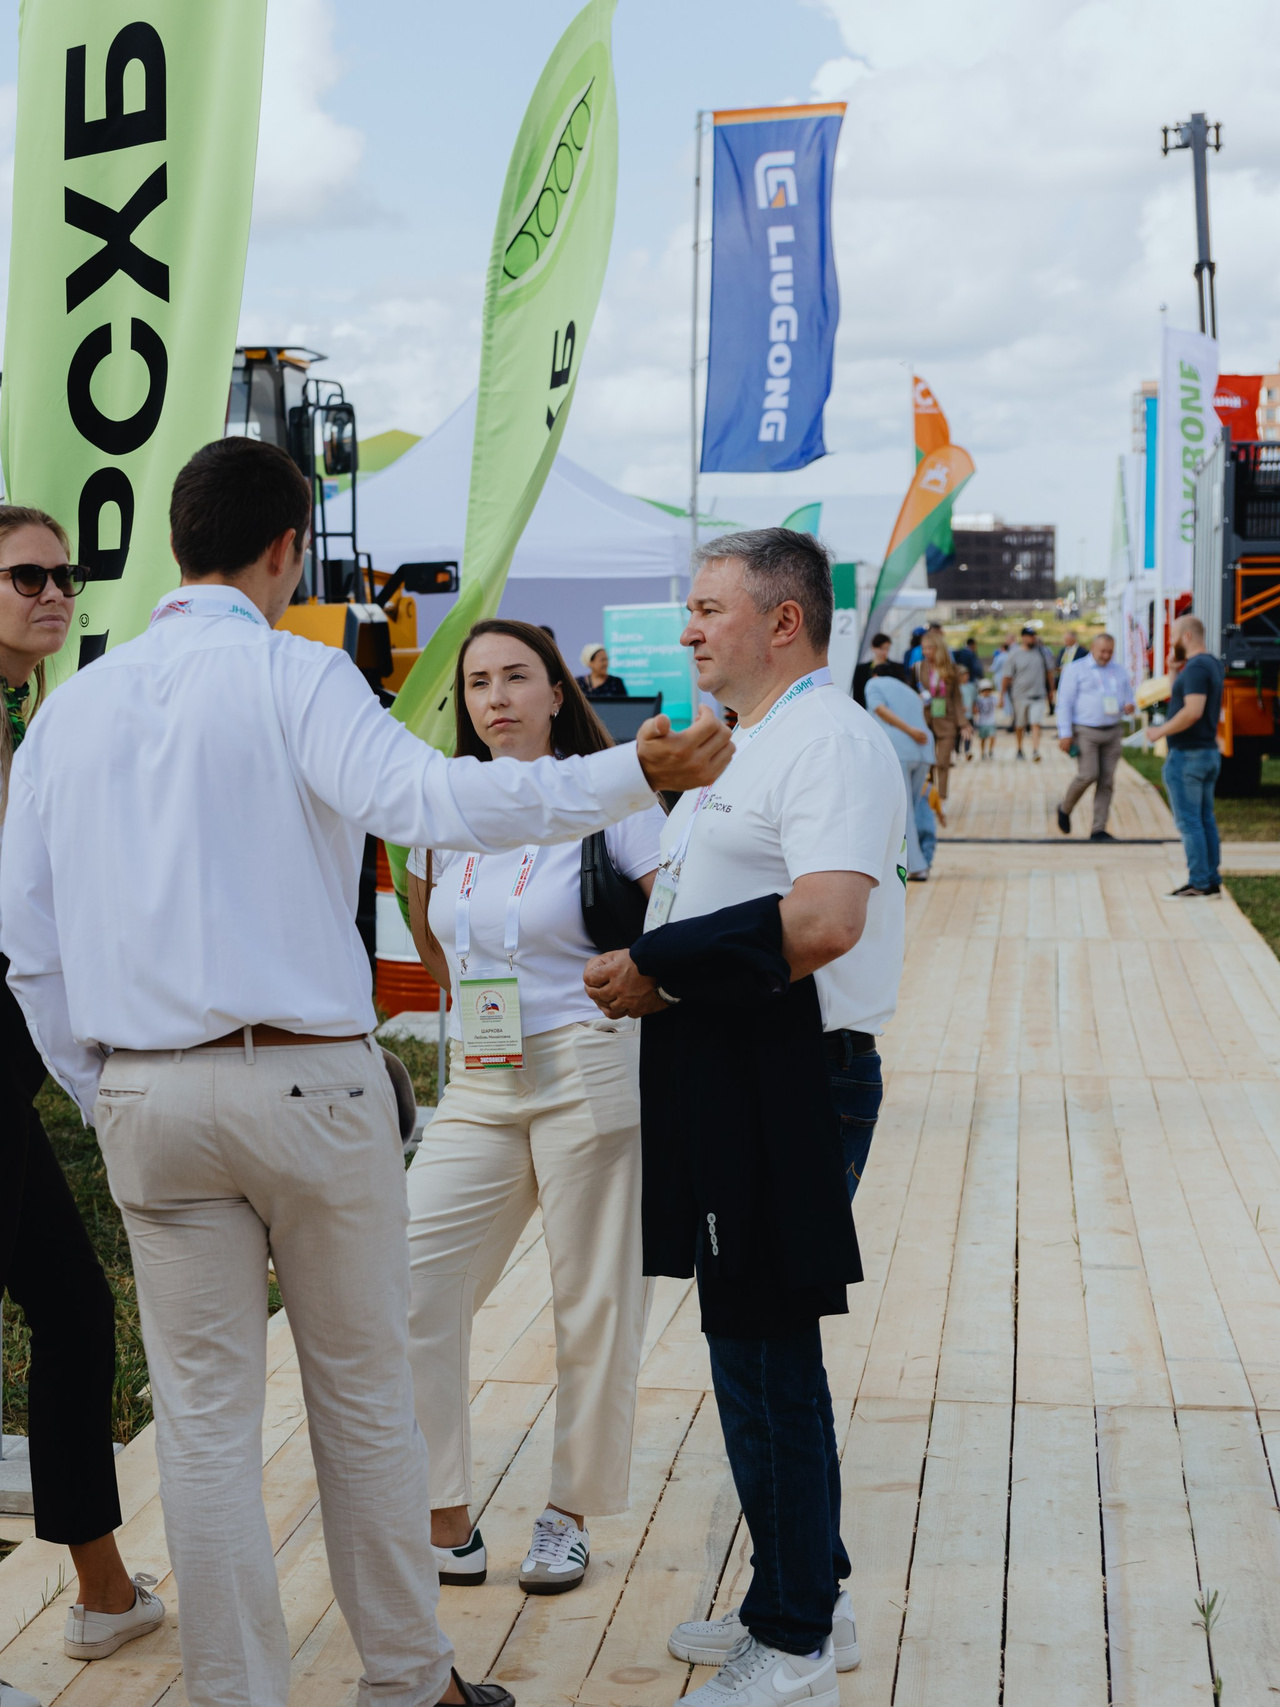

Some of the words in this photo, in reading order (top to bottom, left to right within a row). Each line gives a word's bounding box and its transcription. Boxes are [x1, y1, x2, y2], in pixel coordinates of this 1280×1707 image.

[64, 21, 169, 581] РСХБ
[758, 225, 798, 443] LIUGONG
[838, 614, 853, 636] 2
[748, 676, 815, 739] РОСАГРОЛИЗИНГ
[712, 802, 733, 814] РСХБ
